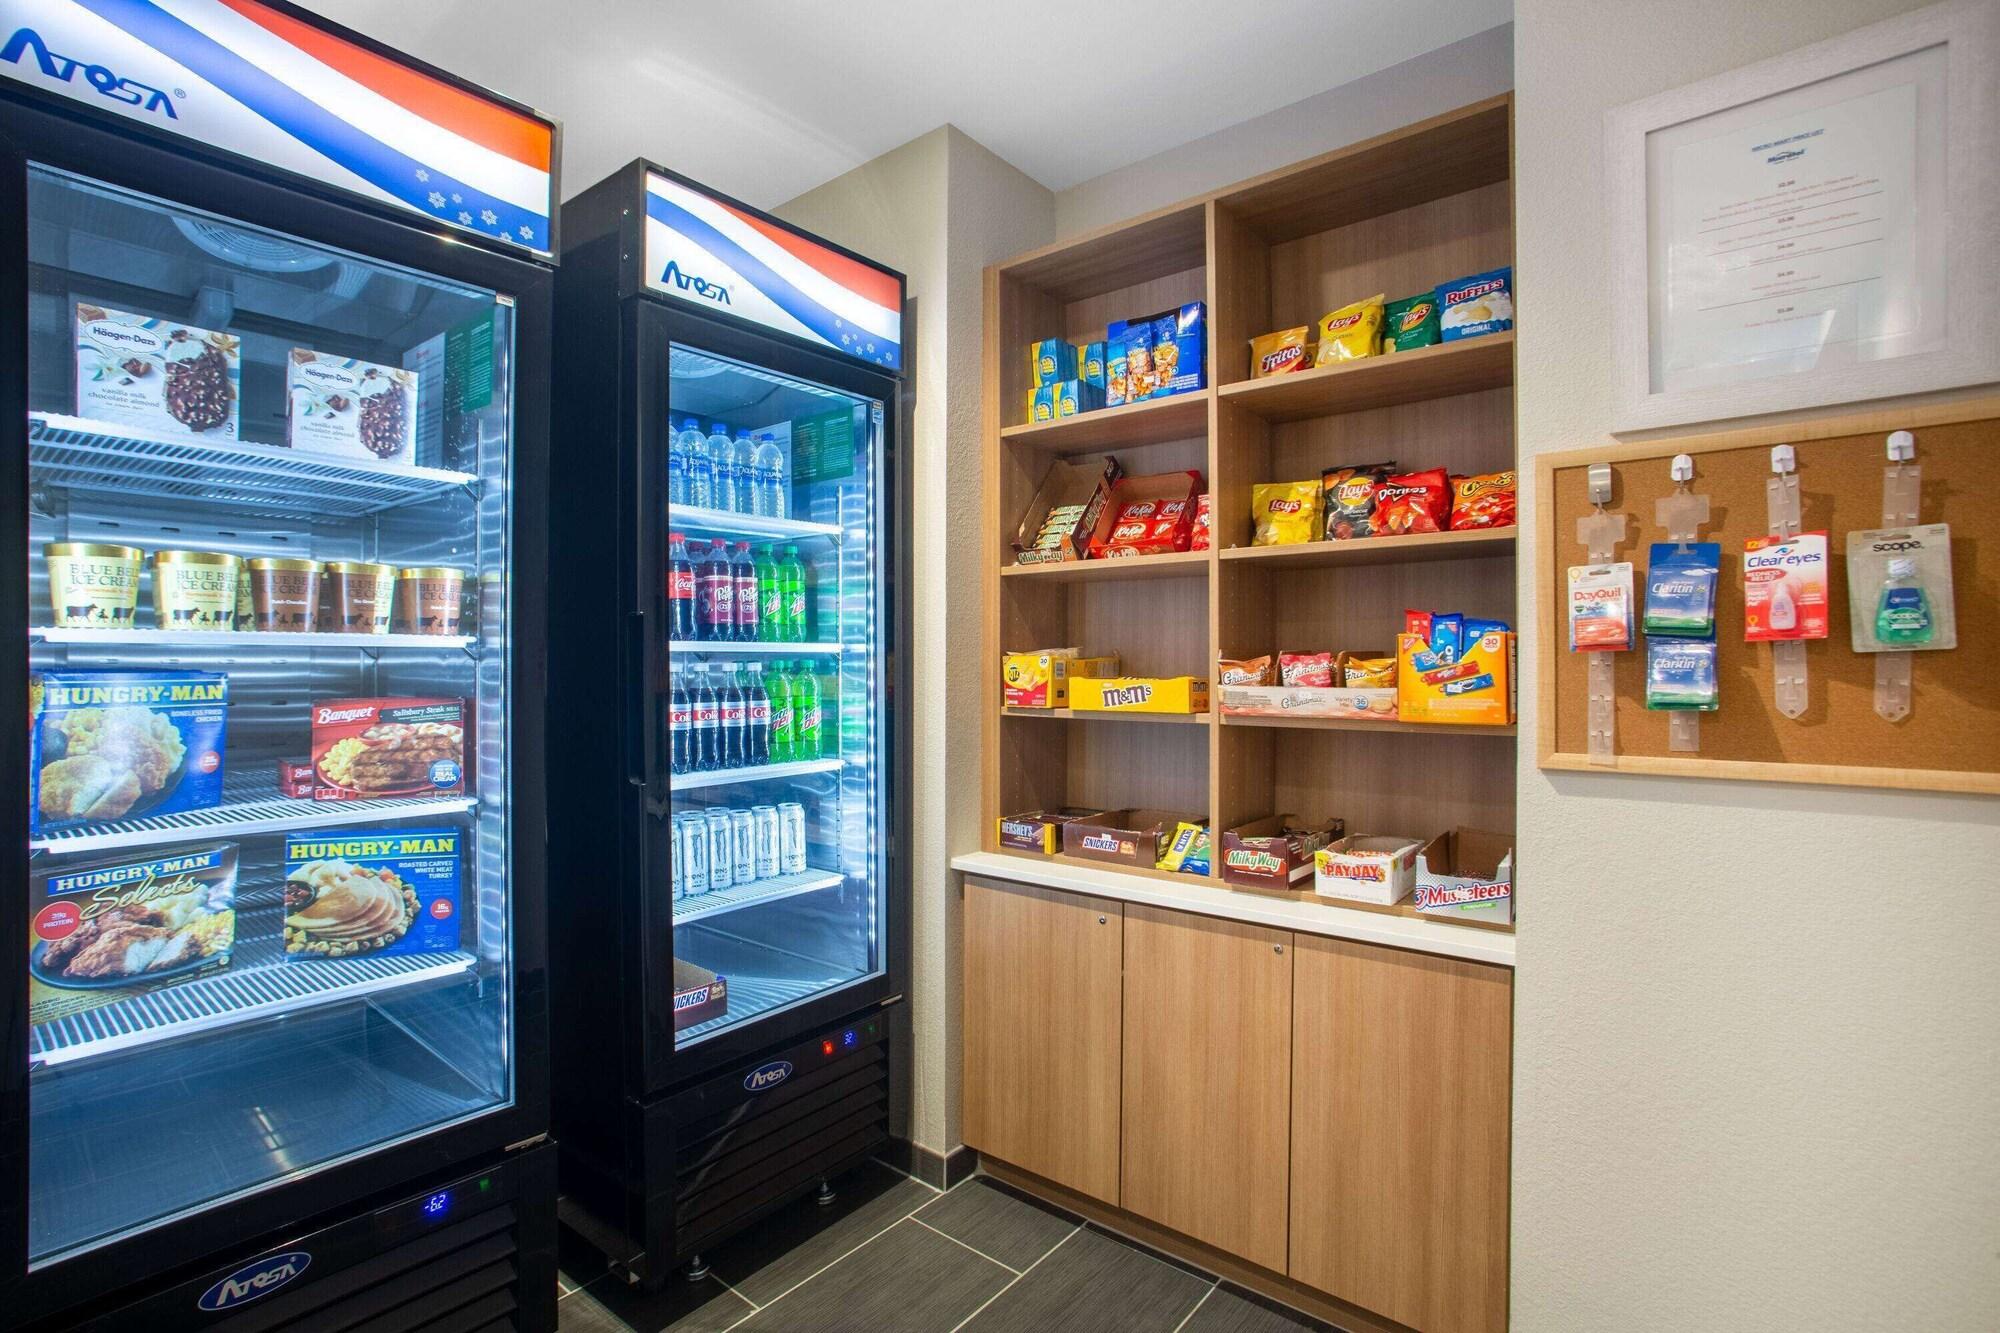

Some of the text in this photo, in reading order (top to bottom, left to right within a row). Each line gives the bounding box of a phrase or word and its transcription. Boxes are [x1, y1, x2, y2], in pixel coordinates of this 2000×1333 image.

[1446, 279, 1504, 305] RUFFLES
[93, 326, 156, 346] Häagen-Dazs
[1461, 324, 1492, 336] ORIGINAL
[1262, 344, 1302, 371] Fritos
[305, 368, 353, 384] Häagen-Dazs
[226, 422, 234, 433] 3
[1873, 541, 1921, 552] scope
[1747, 553, 1821, 568] Clear eyes
[1574, 587, 1621, 602] DayQuil
[1652, 582, 1693, 594] Claritin
[50, 685, 224, 706] HUNGRY-MAN
[1355, 698, 1367, 706] 36
[317, 707, 377, 724] Banquet
[393, 708, 425, 717] Salisbury
[425, 705, 445, 715] Steak
[1001, 821, 1033, 837] HERSHEY'S
[290, 838, 455, 859] HUNGRY-MAN
[1083, 837, 1118, 851] SNICKERS
[1228, 850, 1281, 872] Milky Way
[56, 855, 211, 891] HUNGRY-MAN
[1326, 863, 1379, 878] PAYDAY
[79, 874, 201, 920] Selects
[1416, 883, 1511, 908] 3 Museteers
